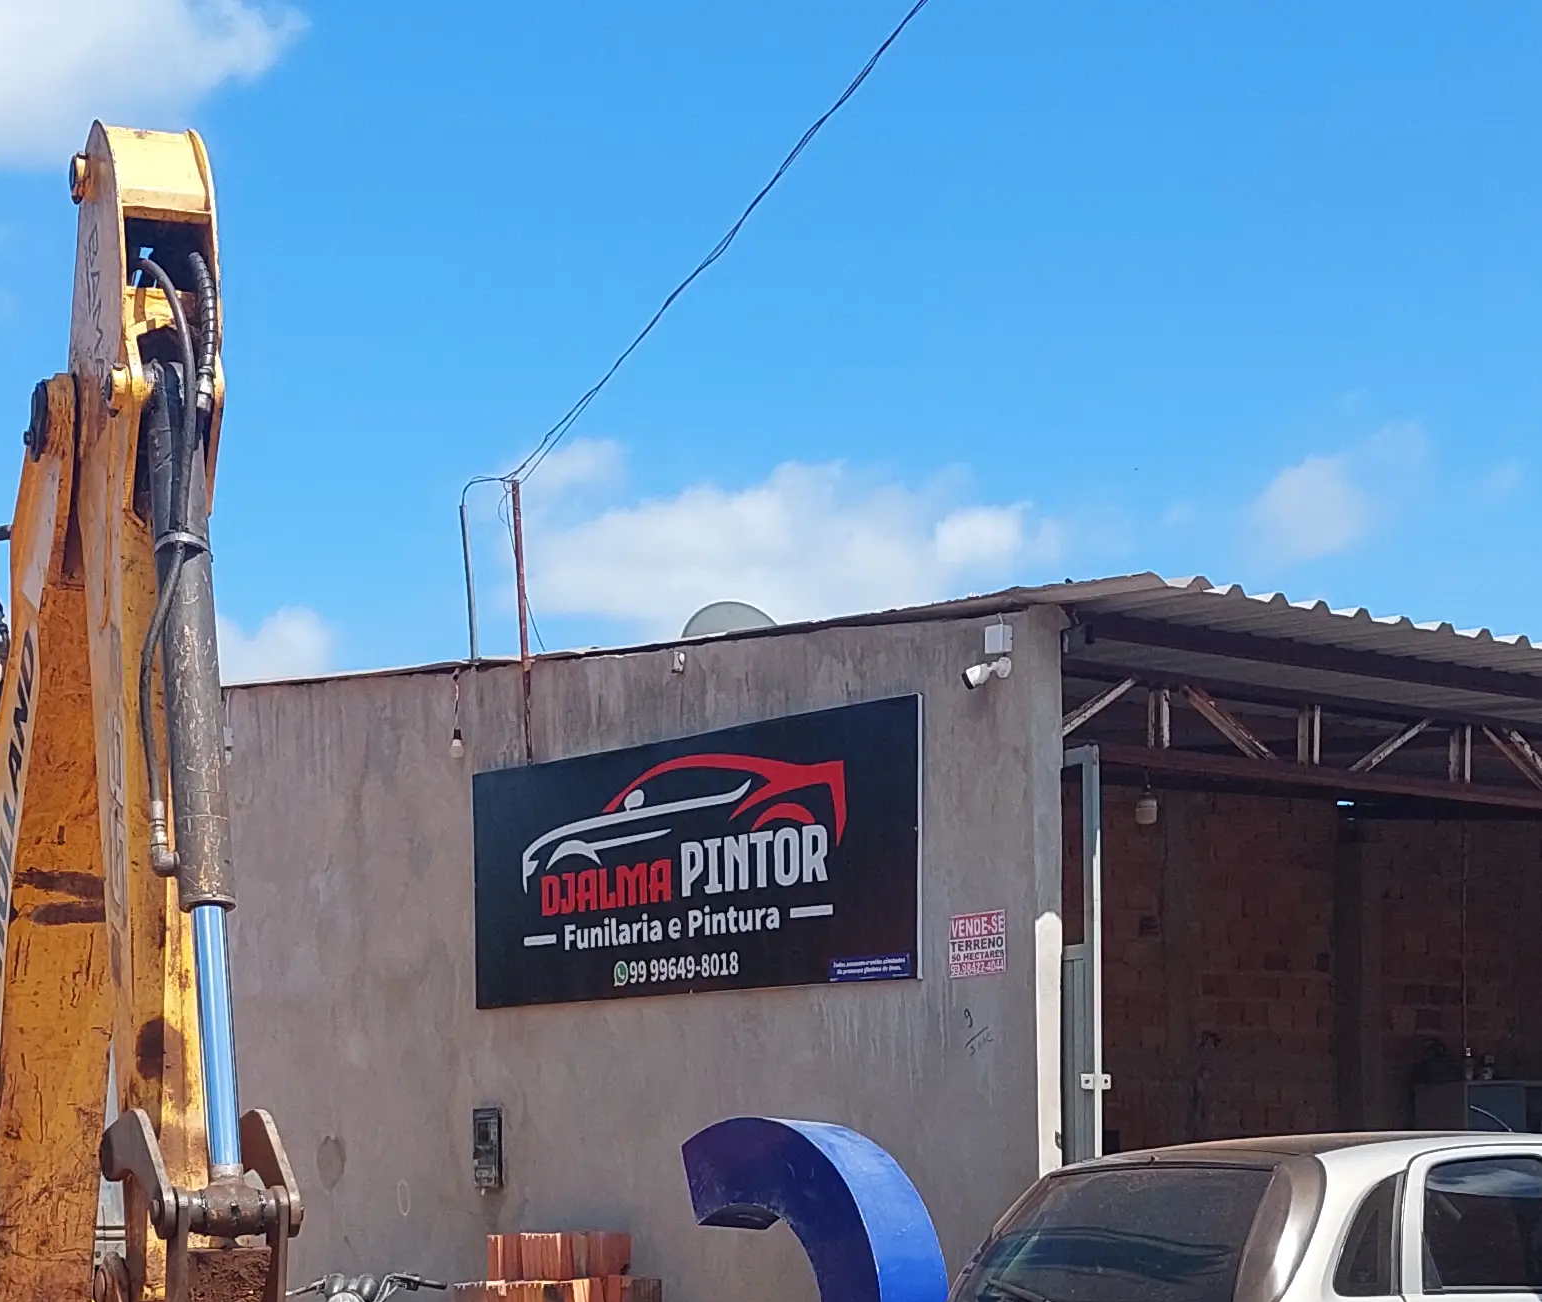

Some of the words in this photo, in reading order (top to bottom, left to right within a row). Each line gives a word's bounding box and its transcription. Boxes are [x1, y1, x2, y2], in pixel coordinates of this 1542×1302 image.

[540, 858, 672, 917] DJALMA
[680, 824, 829, 897] PINTOR
[563, 913, 663, 951] Funilaria
[667, 916, 681, 940] e
[688, 904, 780, 937] Pintura
[951, 914, 1005, 938] VENDE-SE
[950, 936, 1004, 953] TERRENO
[629, 962, 647, 984] 99
[650, 951, 739, 984] 99649-8018
